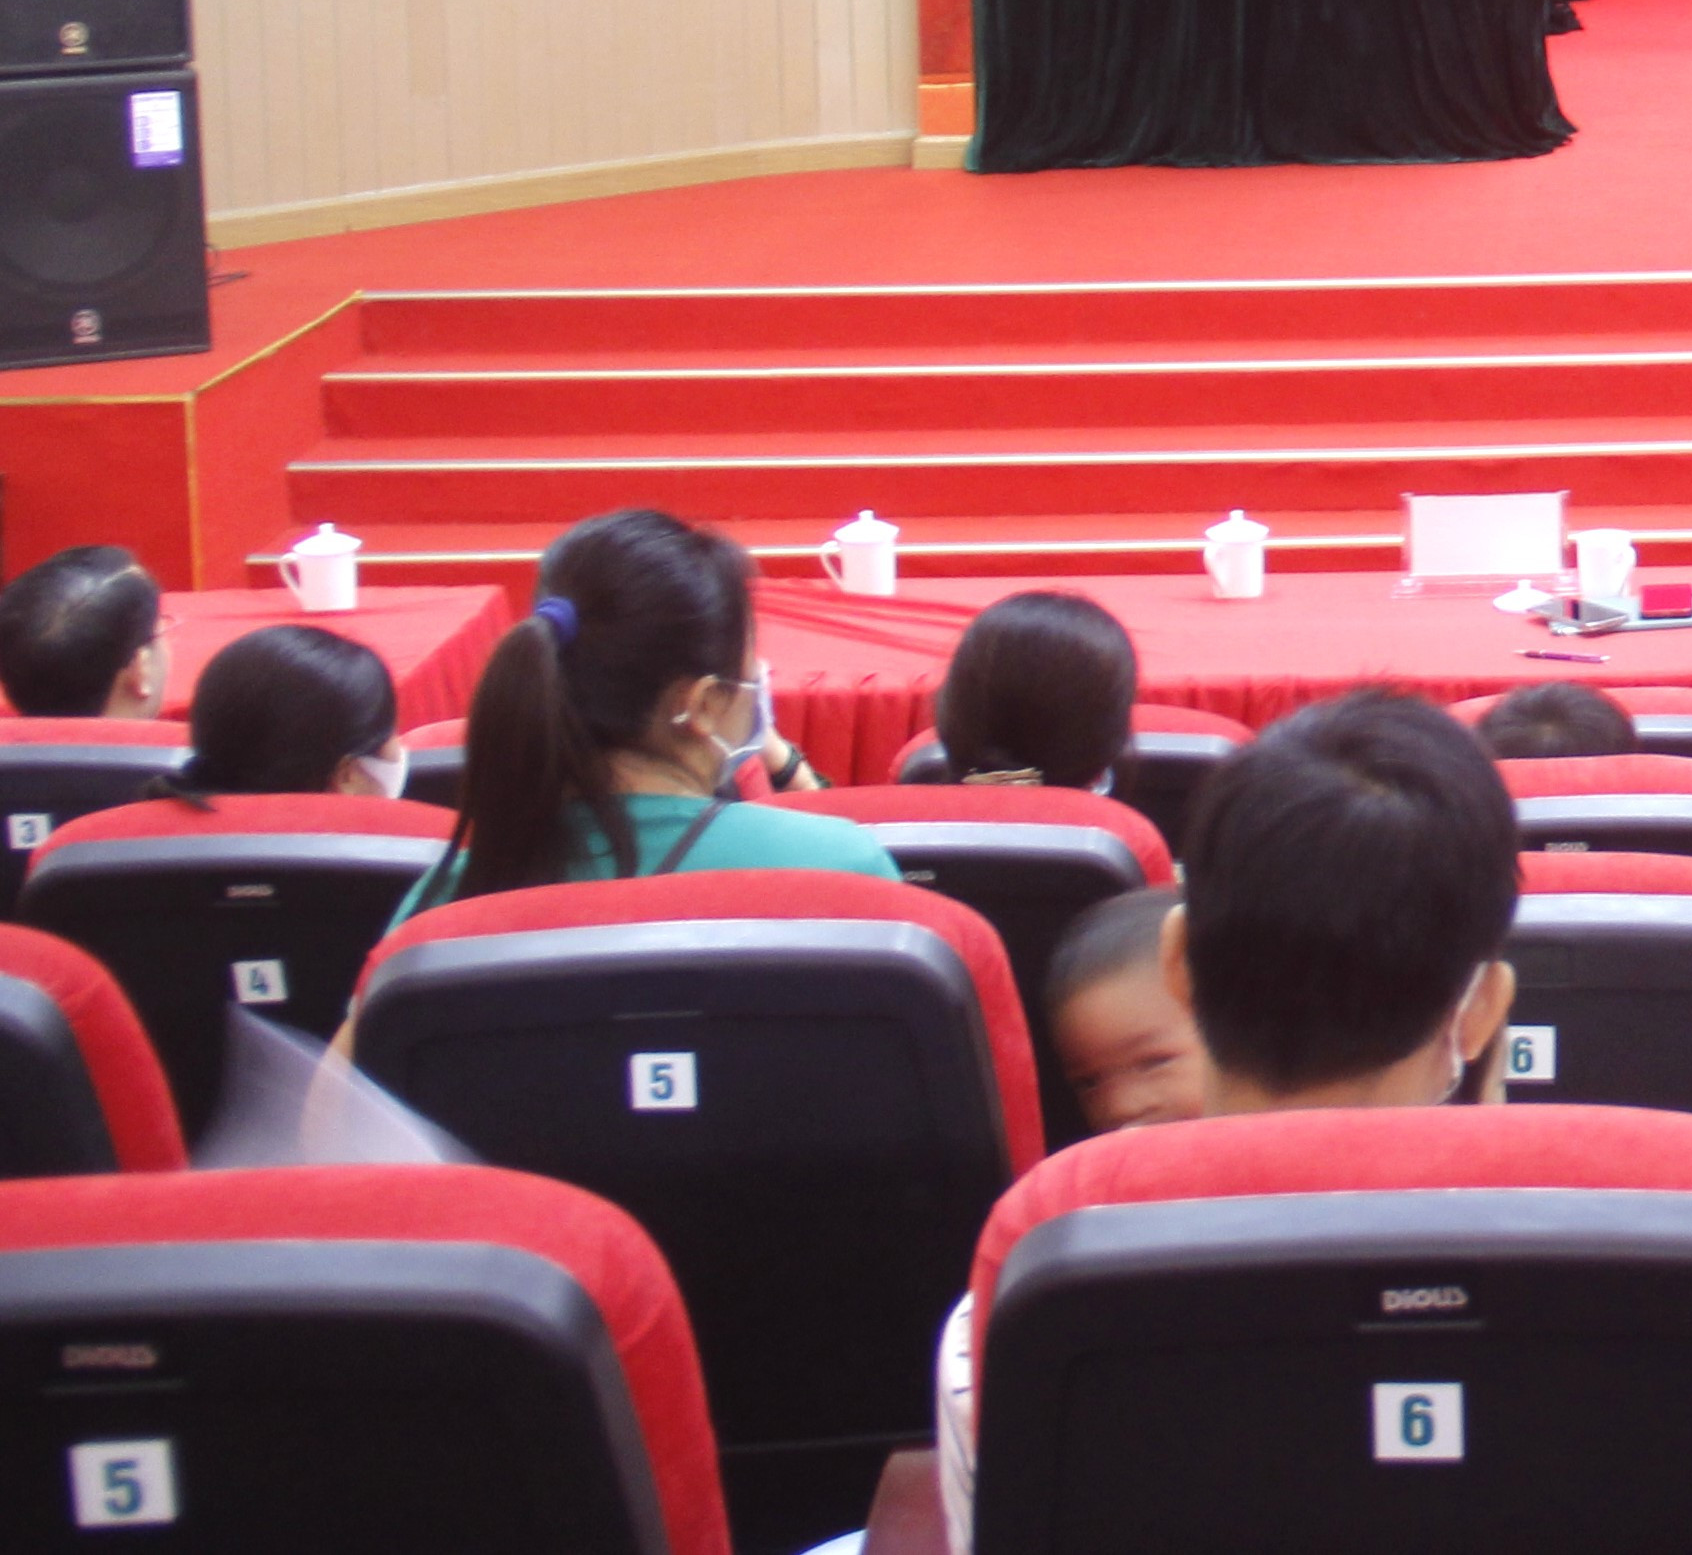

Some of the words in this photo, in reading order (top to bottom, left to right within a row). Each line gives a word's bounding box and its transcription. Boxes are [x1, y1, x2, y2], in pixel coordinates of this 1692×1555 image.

[21, 820, 38, 846] 3
[248, 968, 272, 997] 4
[1512, 1039, 1534, 1074] 6
[650, 1063, 676, 1102] 5
[1401, 1395, 1435, 1449] 6
[104, 1460, 145, 1519] 5
